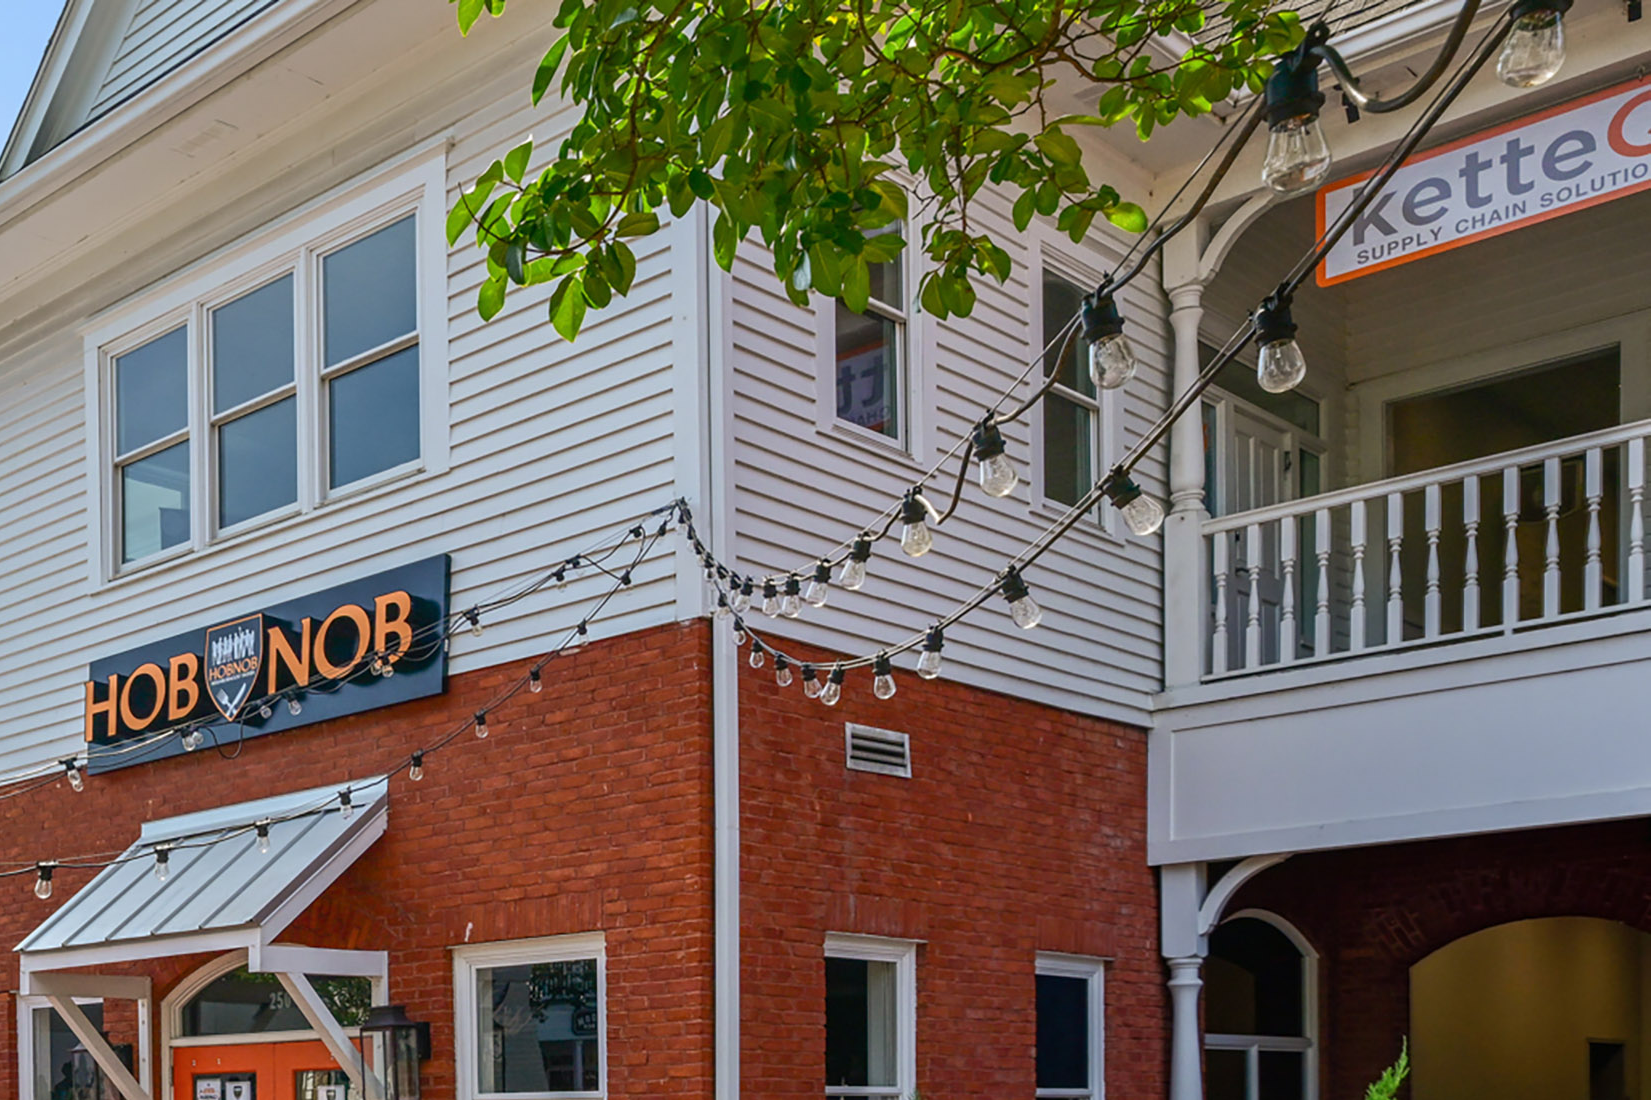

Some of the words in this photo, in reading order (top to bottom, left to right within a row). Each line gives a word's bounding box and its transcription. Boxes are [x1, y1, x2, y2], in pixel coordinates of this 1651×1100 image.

[1356, 226, 1443, 265] SUPPLY
[1455, 200, 1527, 235] CHAIN
[85, 652, 199, 742] HOB
[267, 590, 412, 695] NOB
[209, 655, 258, 681] HOBNOB
